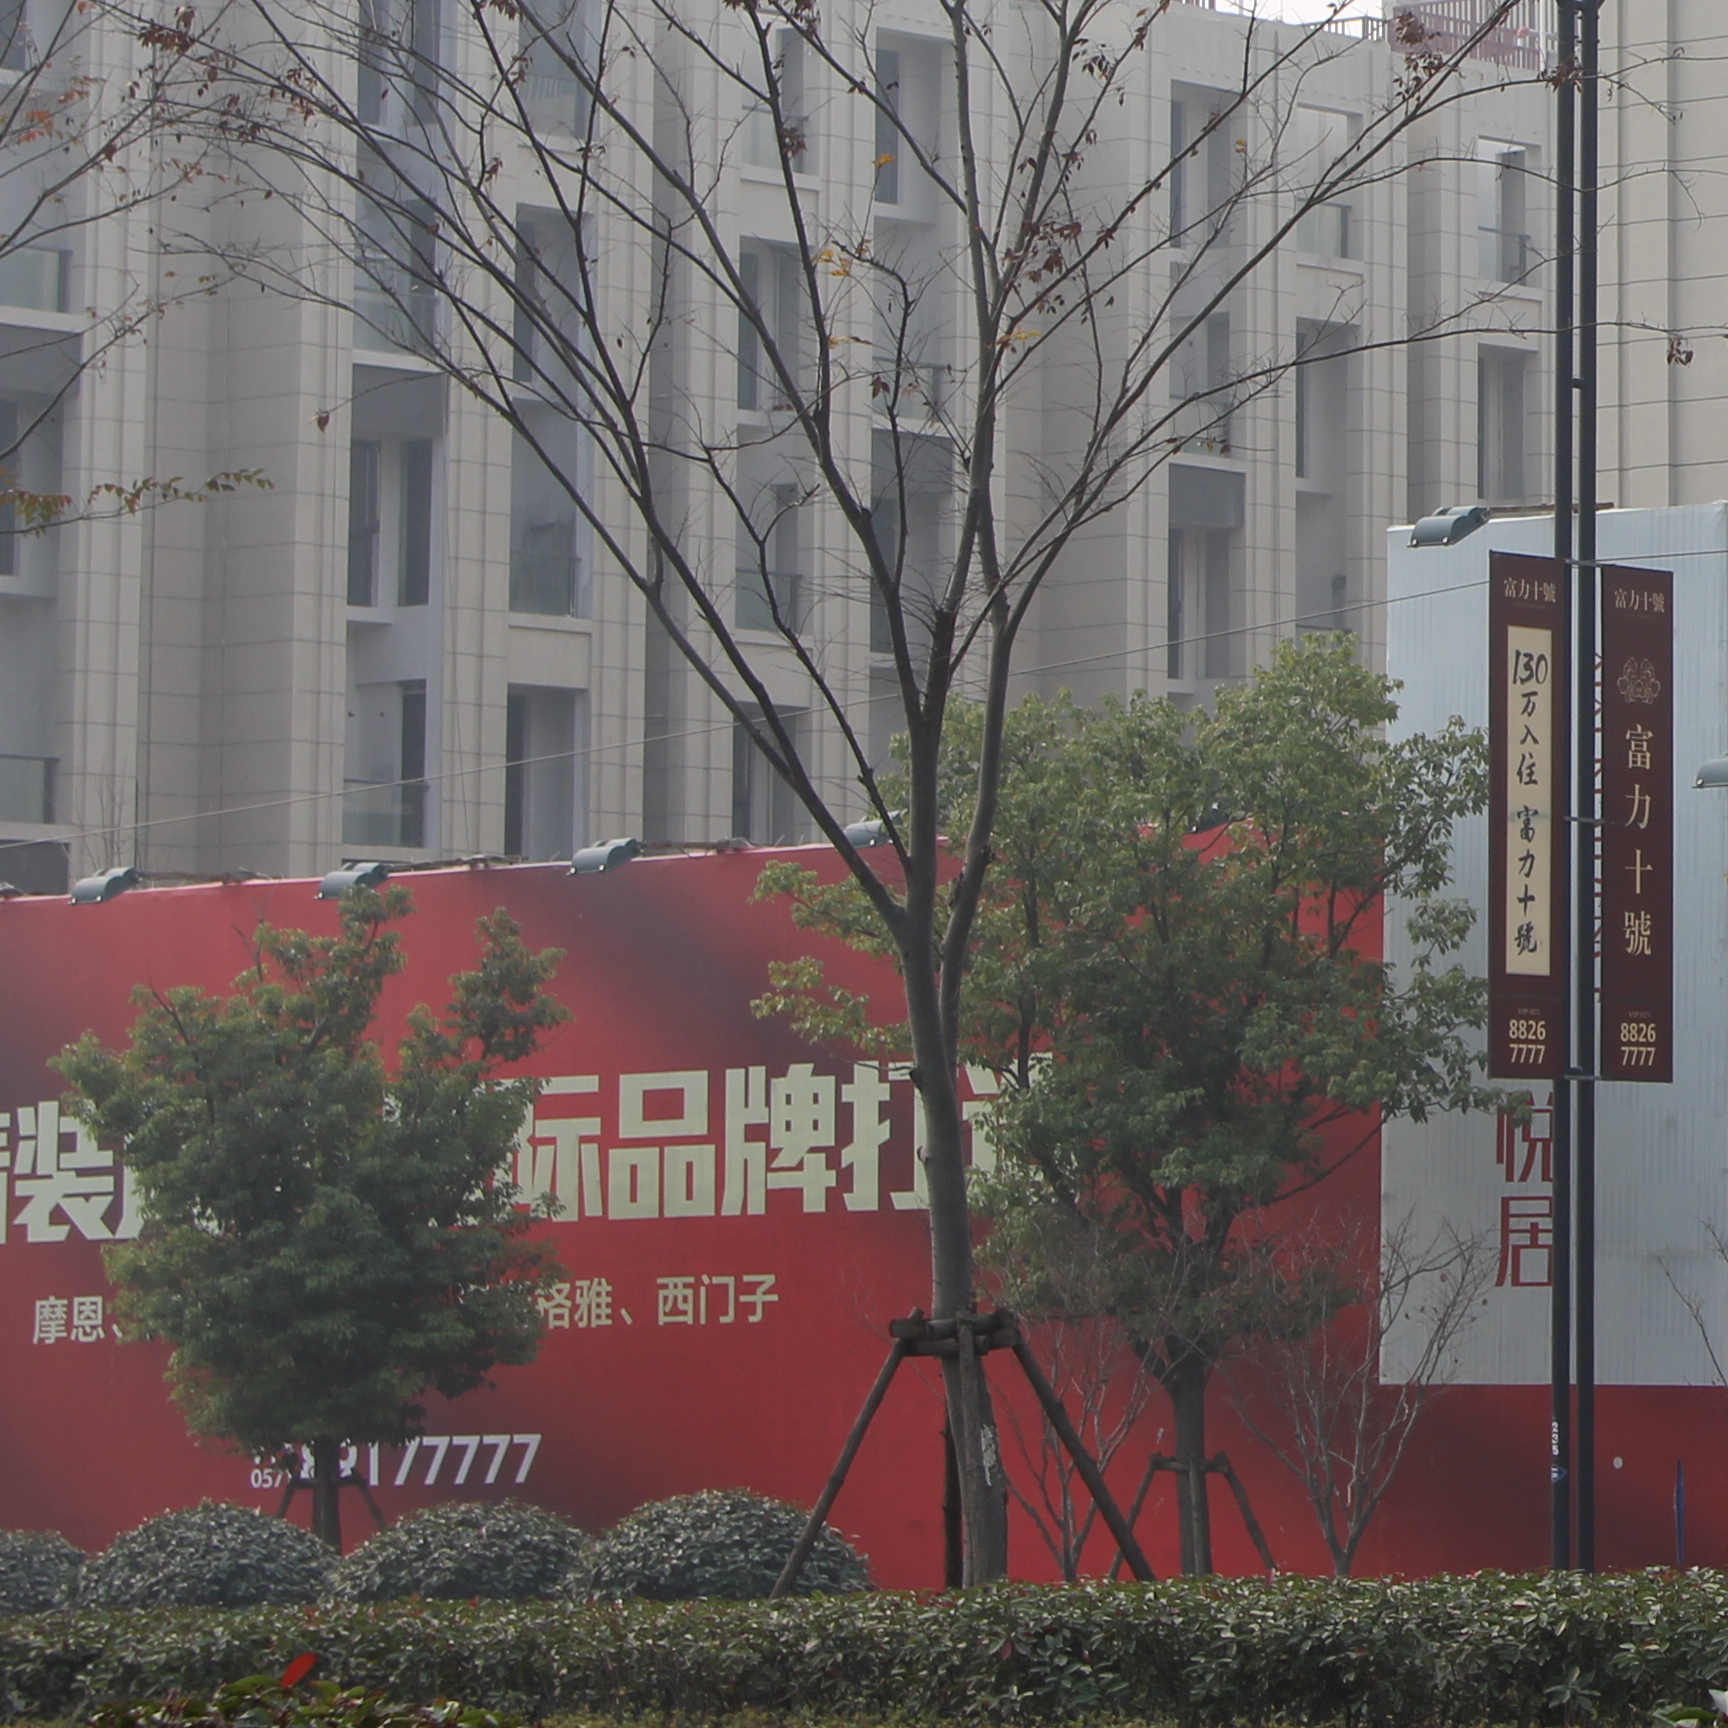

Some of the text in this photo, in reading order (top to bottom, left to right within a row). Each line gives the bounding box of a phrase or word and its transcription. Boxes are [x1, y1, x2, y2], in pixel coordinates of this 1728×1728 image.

[1622, 723, 1655, 957] 富力十號
[1509, 1019, 1547, 1041] 8826
[1620, 1023, 1657, 1043] 8826
[1509, 1043, 1546, 1064] 7777
[1620, 1046, 1656, 1067] 7777
